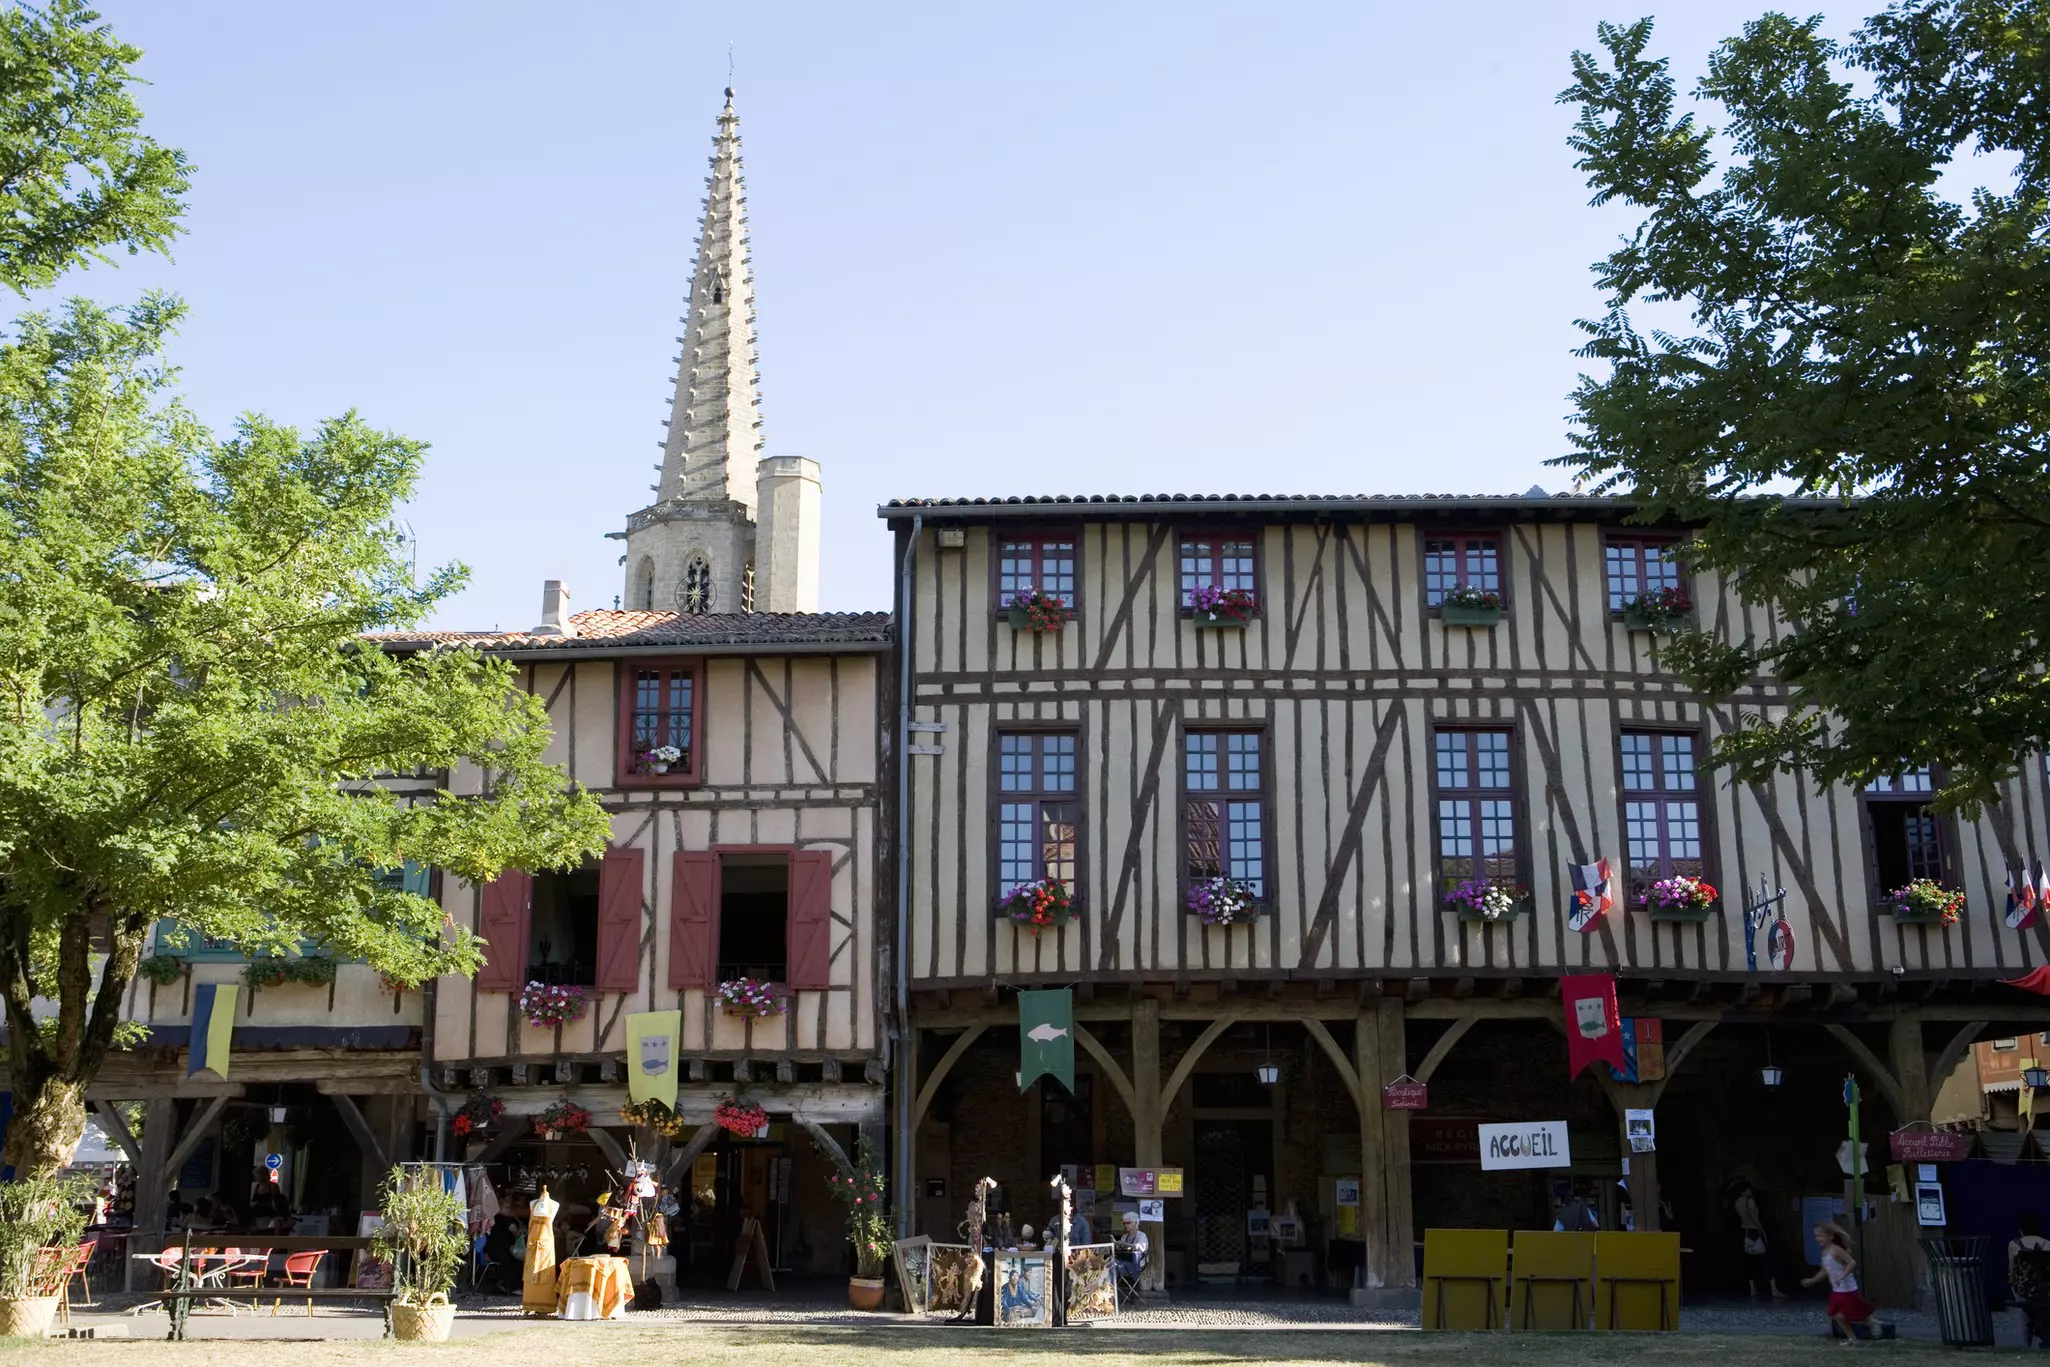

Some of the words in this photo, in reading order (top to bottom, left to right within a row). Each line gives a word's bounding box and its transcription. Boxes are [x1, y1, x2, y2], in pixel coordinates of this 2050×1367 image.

[1898, 1133, 1928, 1146] Accueil
[1929, 1135, 1955, 1148] Public
[1902, 1147, 1952, 1159] Billetterie
